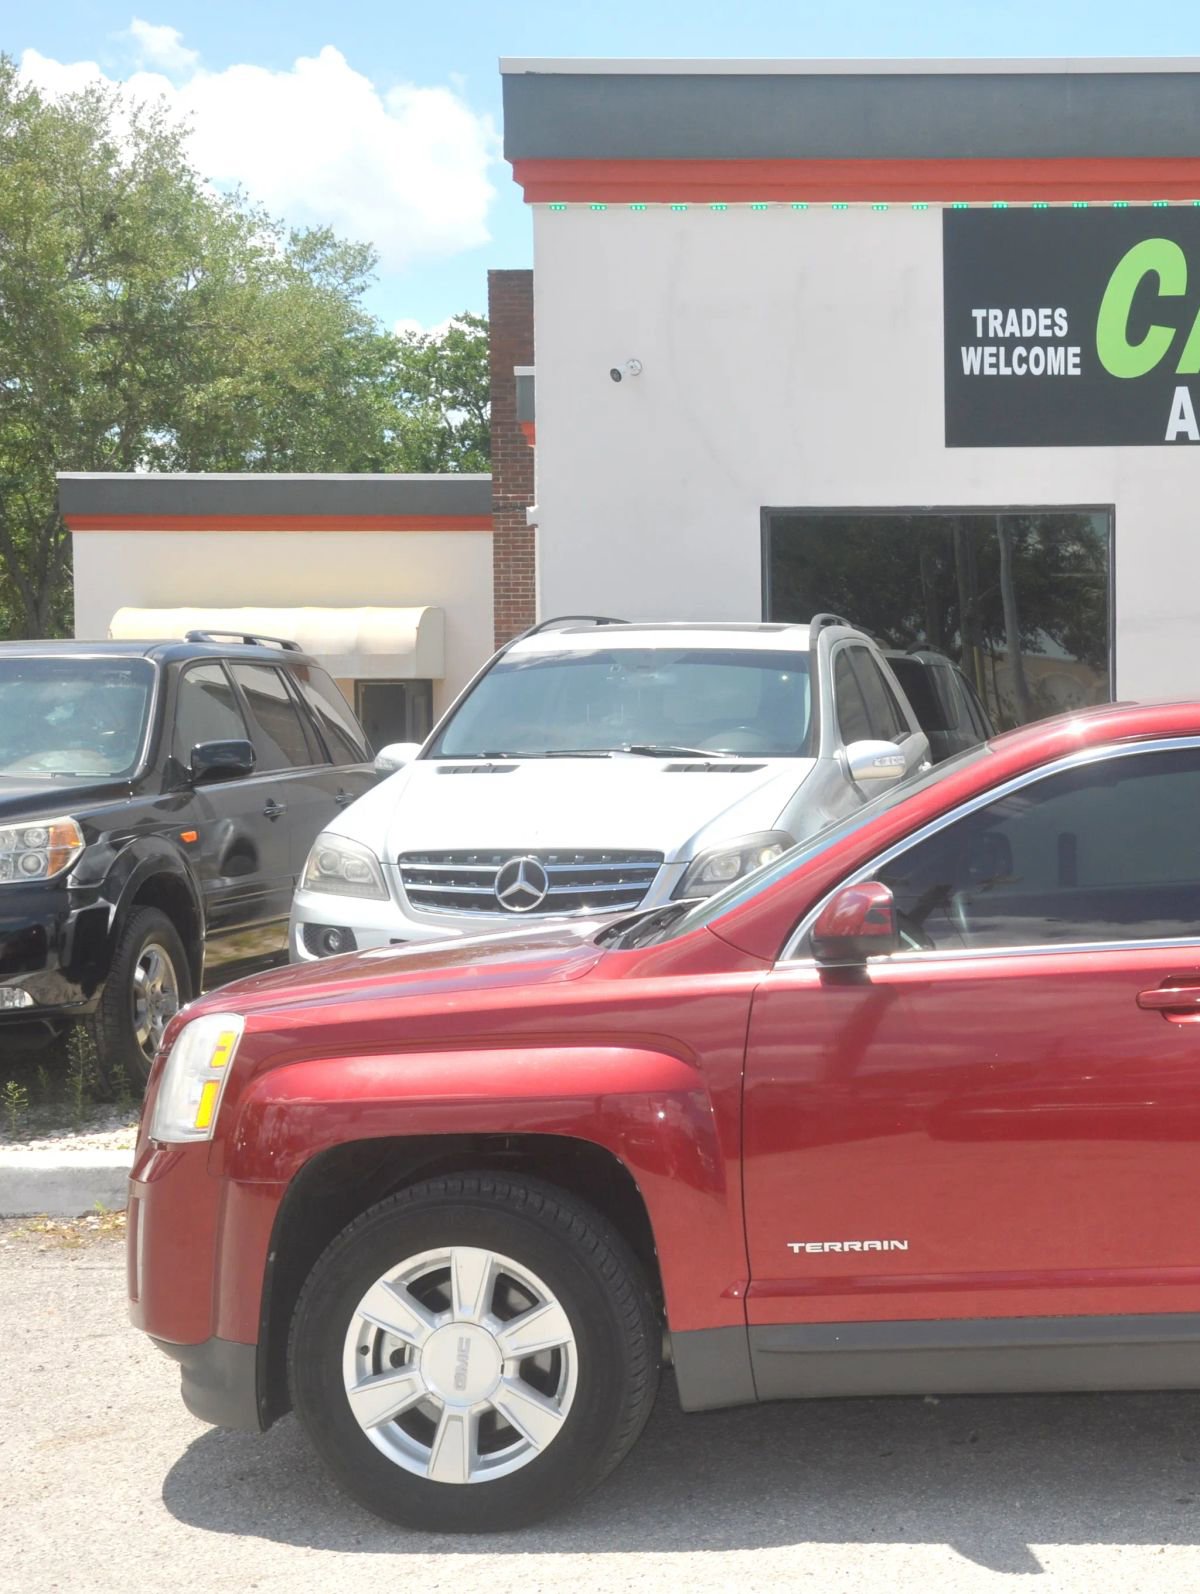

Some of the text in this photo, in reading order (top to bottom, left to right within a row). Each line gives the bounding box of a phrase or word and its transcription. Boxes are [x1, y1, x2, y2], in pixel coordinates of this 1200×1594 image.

[971, 307, 1069, 338] TRADES
[960, 345, 1081, 376] WELCOME
[787, 1240, 909, 1254] TERRAIN
[454, 1336, 472, 1391] GMC
